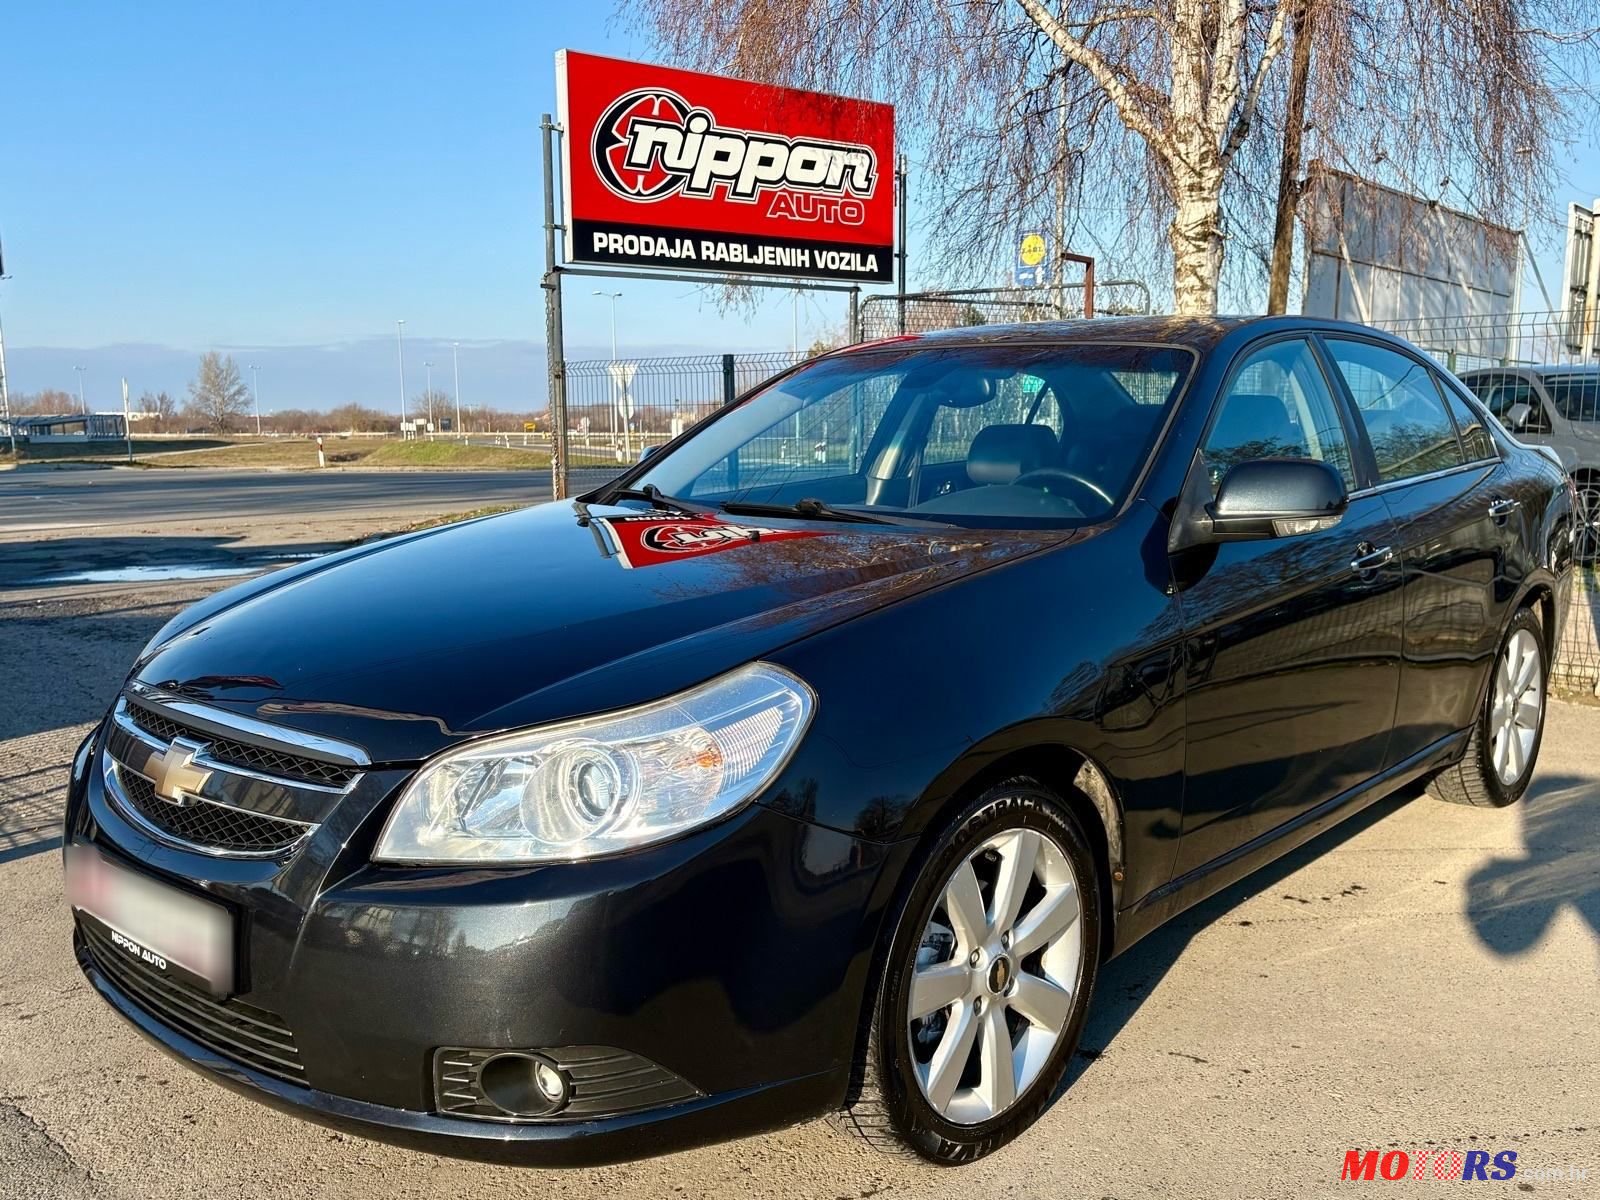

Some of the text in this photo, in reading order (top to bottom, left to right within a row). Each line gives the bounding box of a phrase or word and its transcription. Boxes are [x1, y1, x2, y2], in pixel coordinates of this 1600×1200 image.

[625, 109, 873, 199] nippon
[767, 193, 865, 225] AUTO
[593, 231, 879, 273] PRODAJA RABLJENIH VOZILA
[112, 931, 166, 970] NIPPON AUTO
